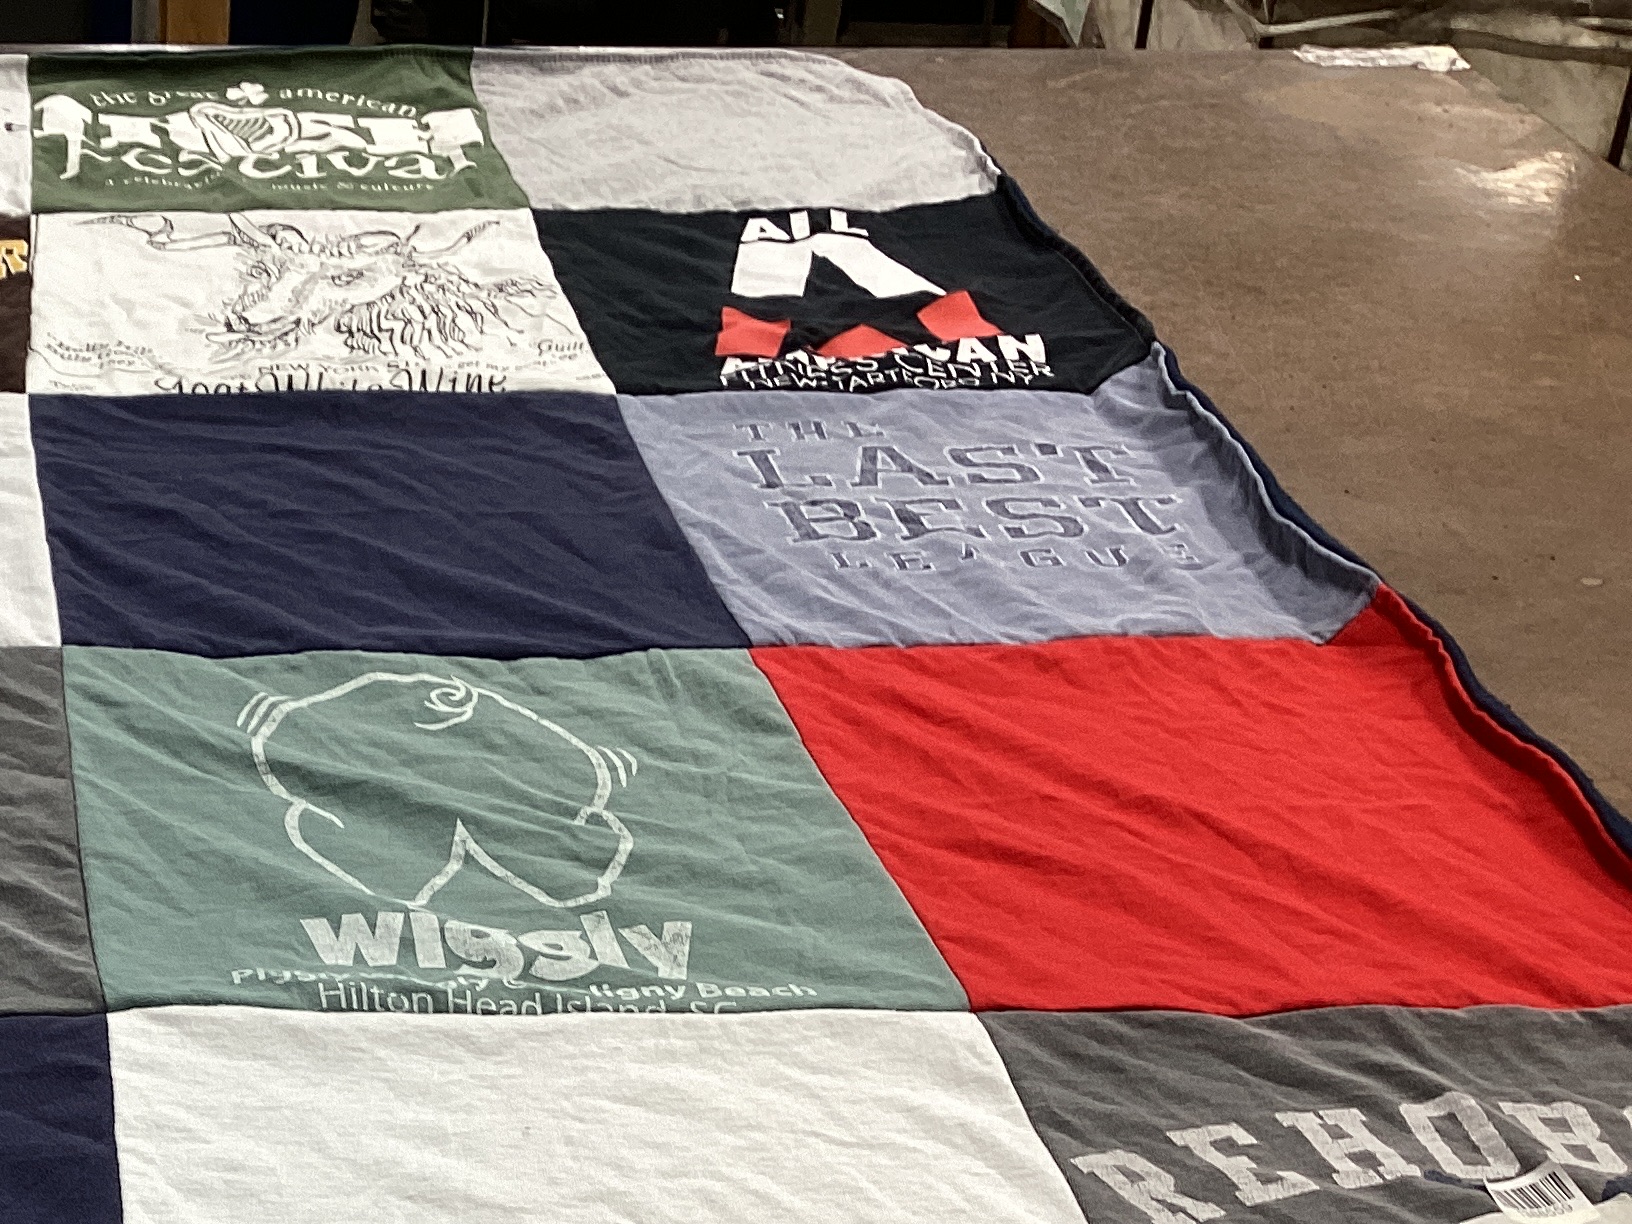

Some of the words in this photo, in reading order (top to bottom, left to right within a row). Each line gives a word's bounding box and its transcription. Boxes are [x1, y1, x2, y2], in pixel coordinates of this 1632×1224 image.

[279, 87, 417, 118] american
[733, 420, 886, 441] THE
[732, 444, 1136, 489] LAST
[765, 494, 1184, 543] BEST
[319, 982, 433, 1011] Hilton
[446, 986, 543, 1014] Head
[695, 982, 818, 998] Beach
